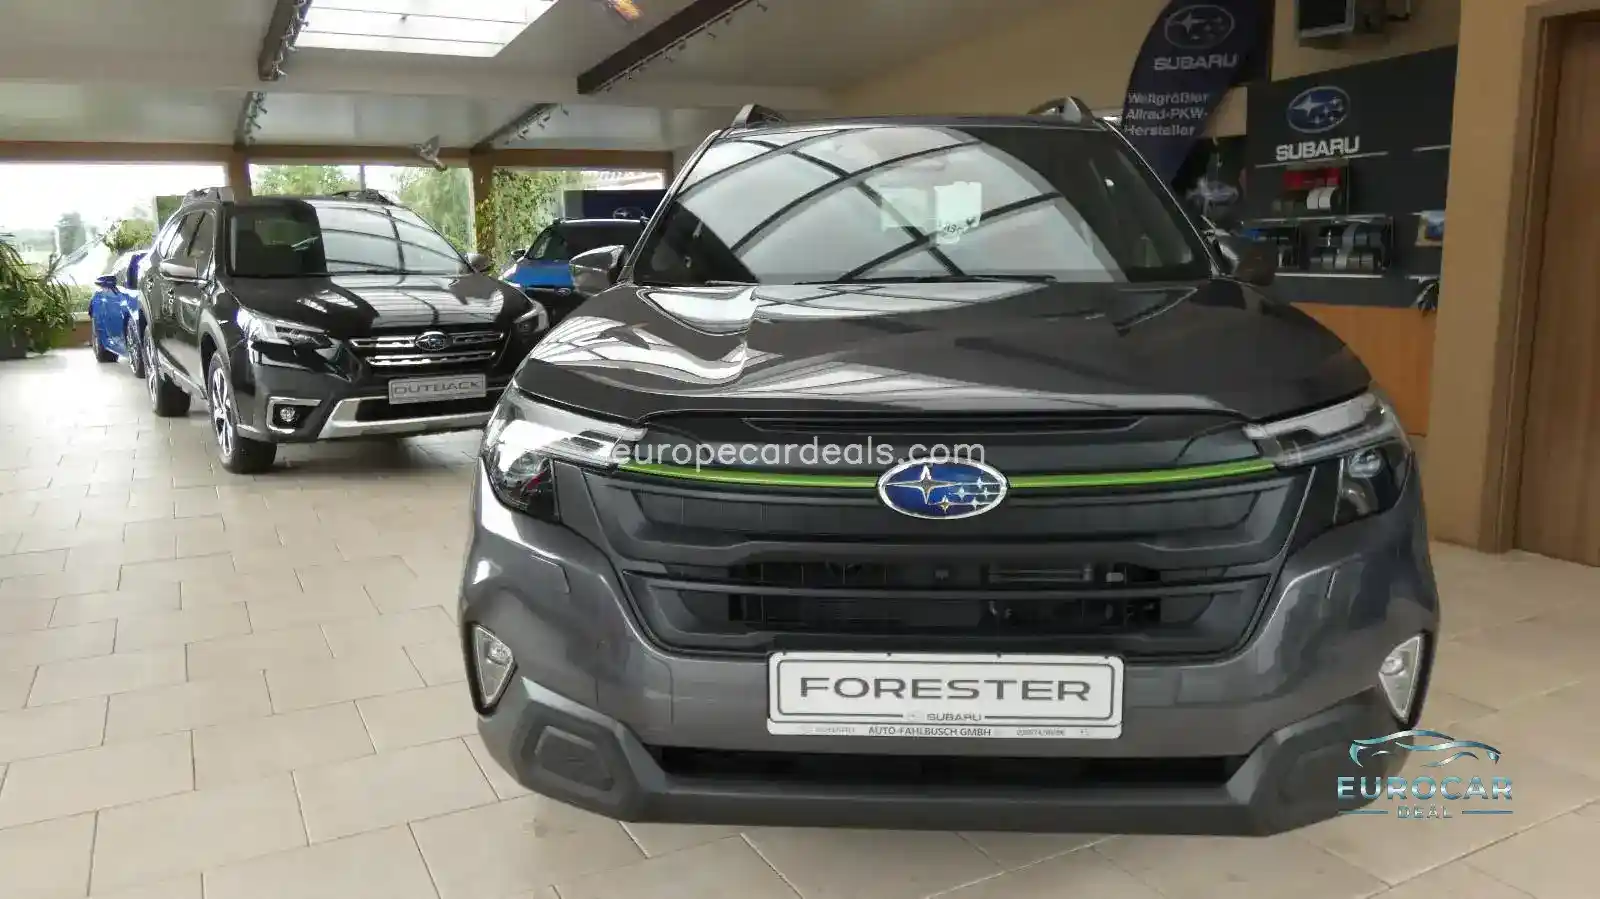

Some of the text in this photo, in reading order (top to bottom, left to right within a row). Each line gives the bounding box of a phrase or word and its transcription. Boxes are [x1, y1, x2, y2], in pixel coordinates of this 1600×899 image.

[1153, 53, 1239, 70] SUBARU
[1276, 135, 1361, 162] SUBARU
[800, 676, 1091, 702] FORESTER
[927, 713, 982, 721] SUBARU
[960, 728, 991, 737] GMBH
